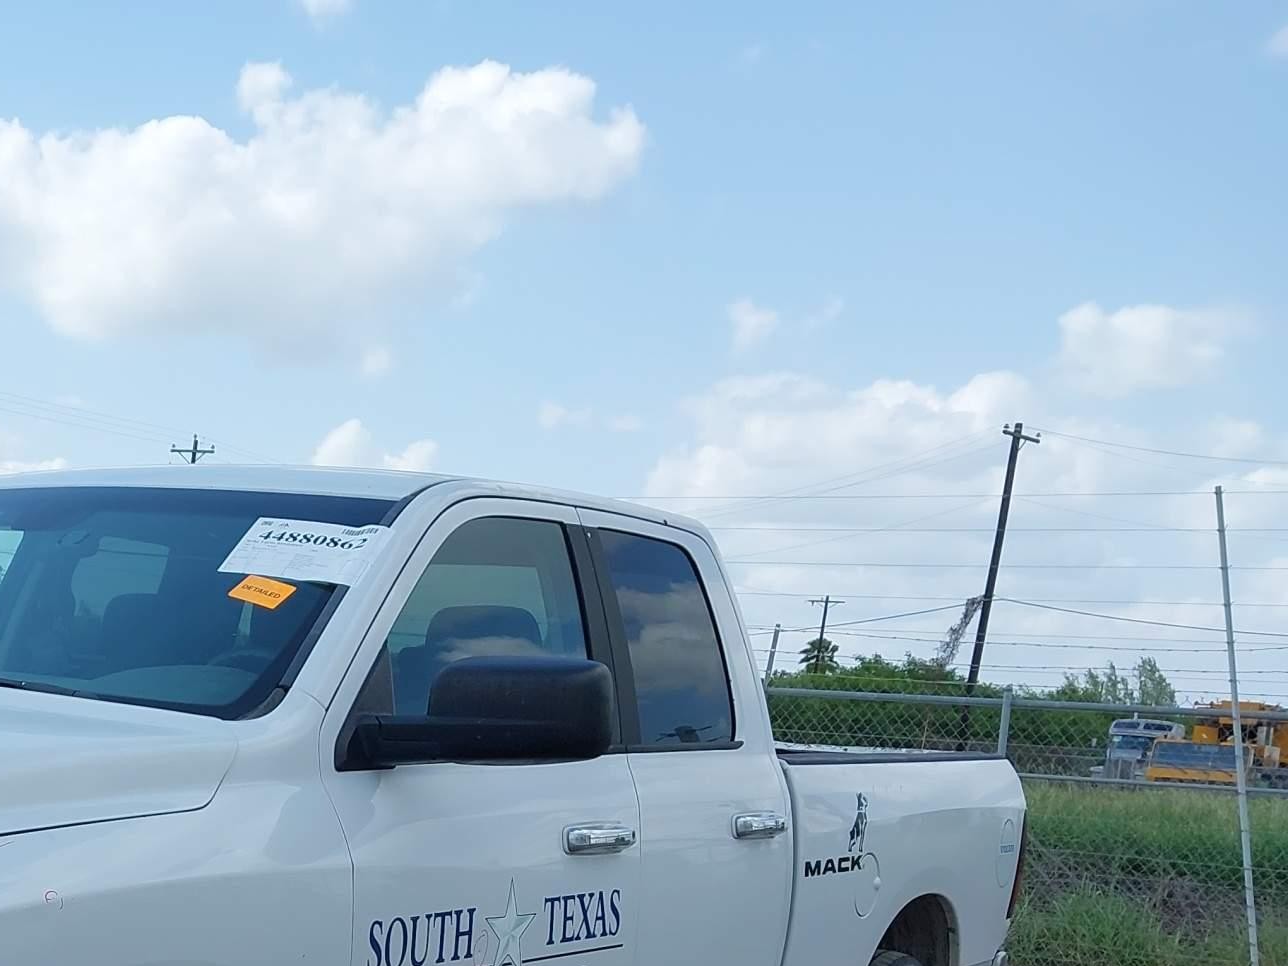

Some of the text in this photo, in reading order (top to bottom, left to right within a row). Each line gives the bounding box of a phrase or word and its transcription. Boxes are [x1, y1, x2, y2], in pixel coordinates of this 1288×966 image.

[258, 529, 368, 550] 44880862
[241, 584, 281, 599] DETAILED
[804, 855, 862, 877] MACK
[544, 889, 622, 945] TEXAS
